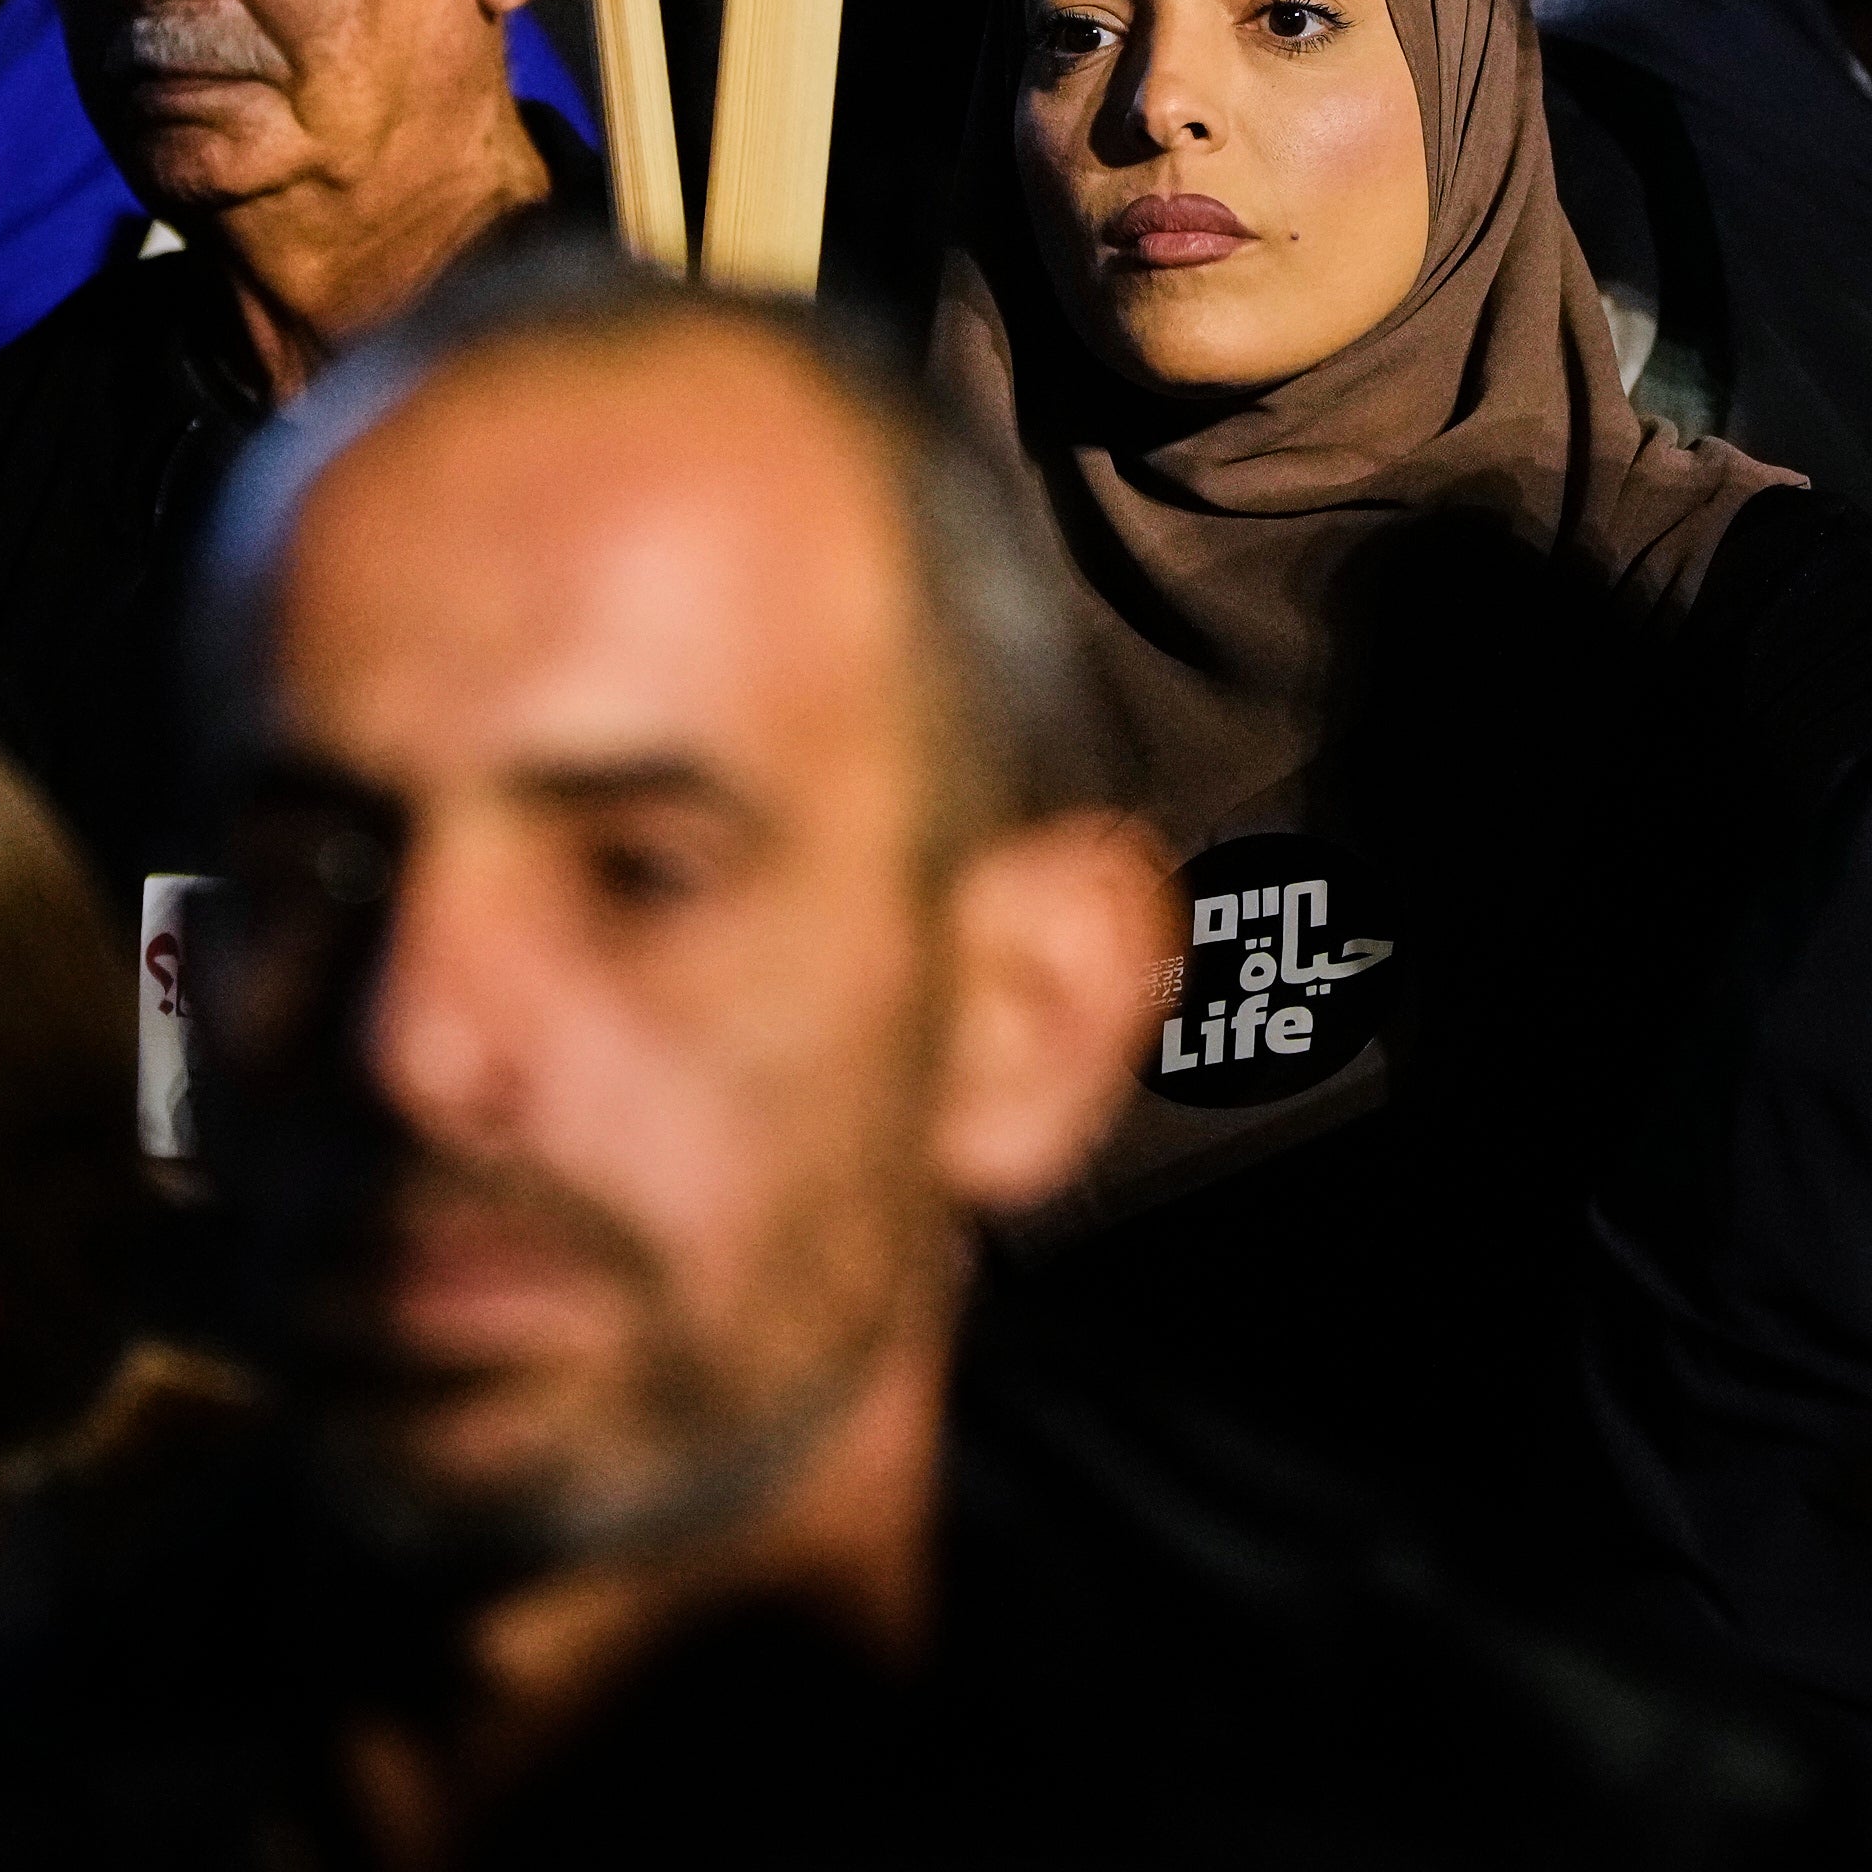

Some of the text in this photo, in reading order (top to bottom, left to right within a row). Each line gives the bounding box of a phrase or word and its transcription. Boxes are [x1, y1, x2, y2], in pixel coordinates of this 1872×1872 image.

[1192, 879, 1328, 946] חיים
[1239, 931, 1395, 997] حياة
[1160, 993, 1314, 1075] Life
